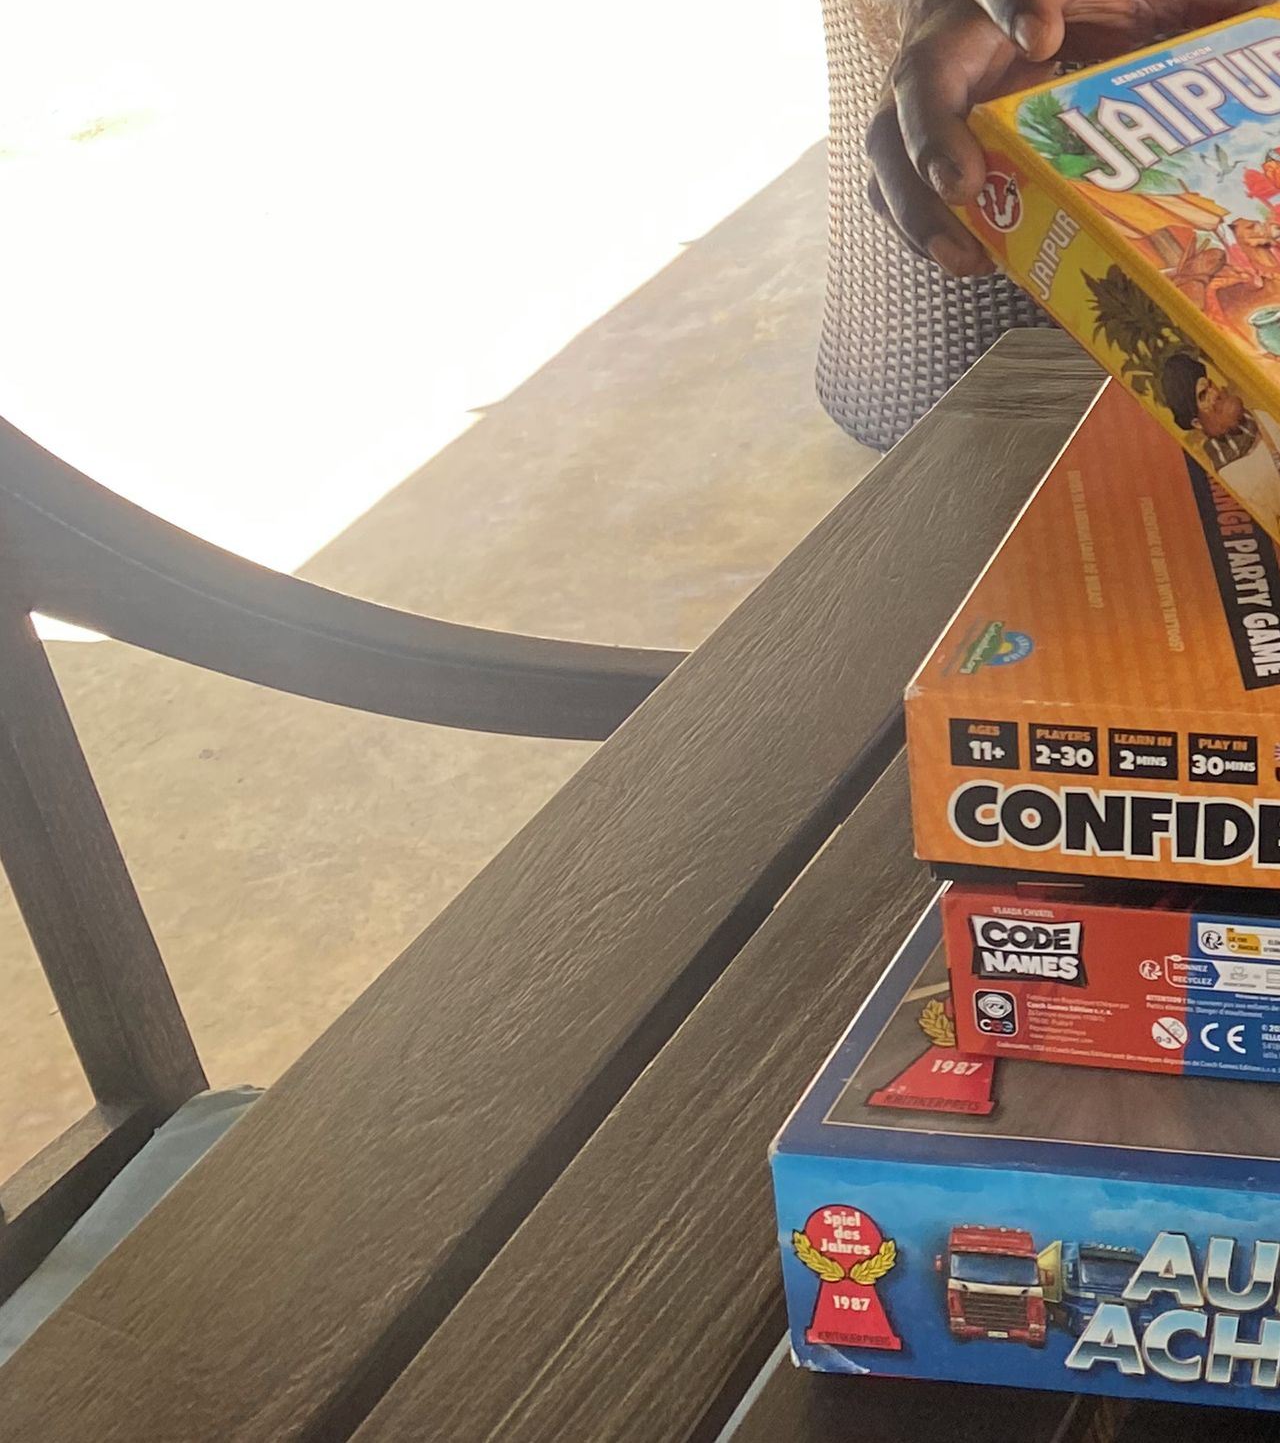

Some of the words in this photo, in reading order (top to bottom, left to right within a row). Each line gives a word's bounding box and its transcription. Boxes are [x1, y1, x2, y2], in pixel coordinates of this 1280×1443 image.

[1028, 208, 1081, 301] JAIPUR
[1223, 537, 1273, 608] PARTY
[967, 723, 1001, 737] AGES
[1035, 728, 1092, 743] PLAYERS
[1114, 733, 1156, 746] LEARN
[1158, 735, 1173, 747] IN
[1199, 738, 1230, 751] PLAY
[1233, 740, 1248, 752] IN
[968, 740, 1005, 761] 11+
[1035, 744, 1095, 768] 2-30
[980, 920, 1072, 950] CODE
[981, 950, 1080, 980] NAMES
[930, 1059, 983, 1076] 1987
[823, 1210, 861, 1227] Spiel
[833, 1226, 861, 1241] des
[820, 1238, 871, 1256] Jahres
[832, 1294, 871, 1312] 1987
